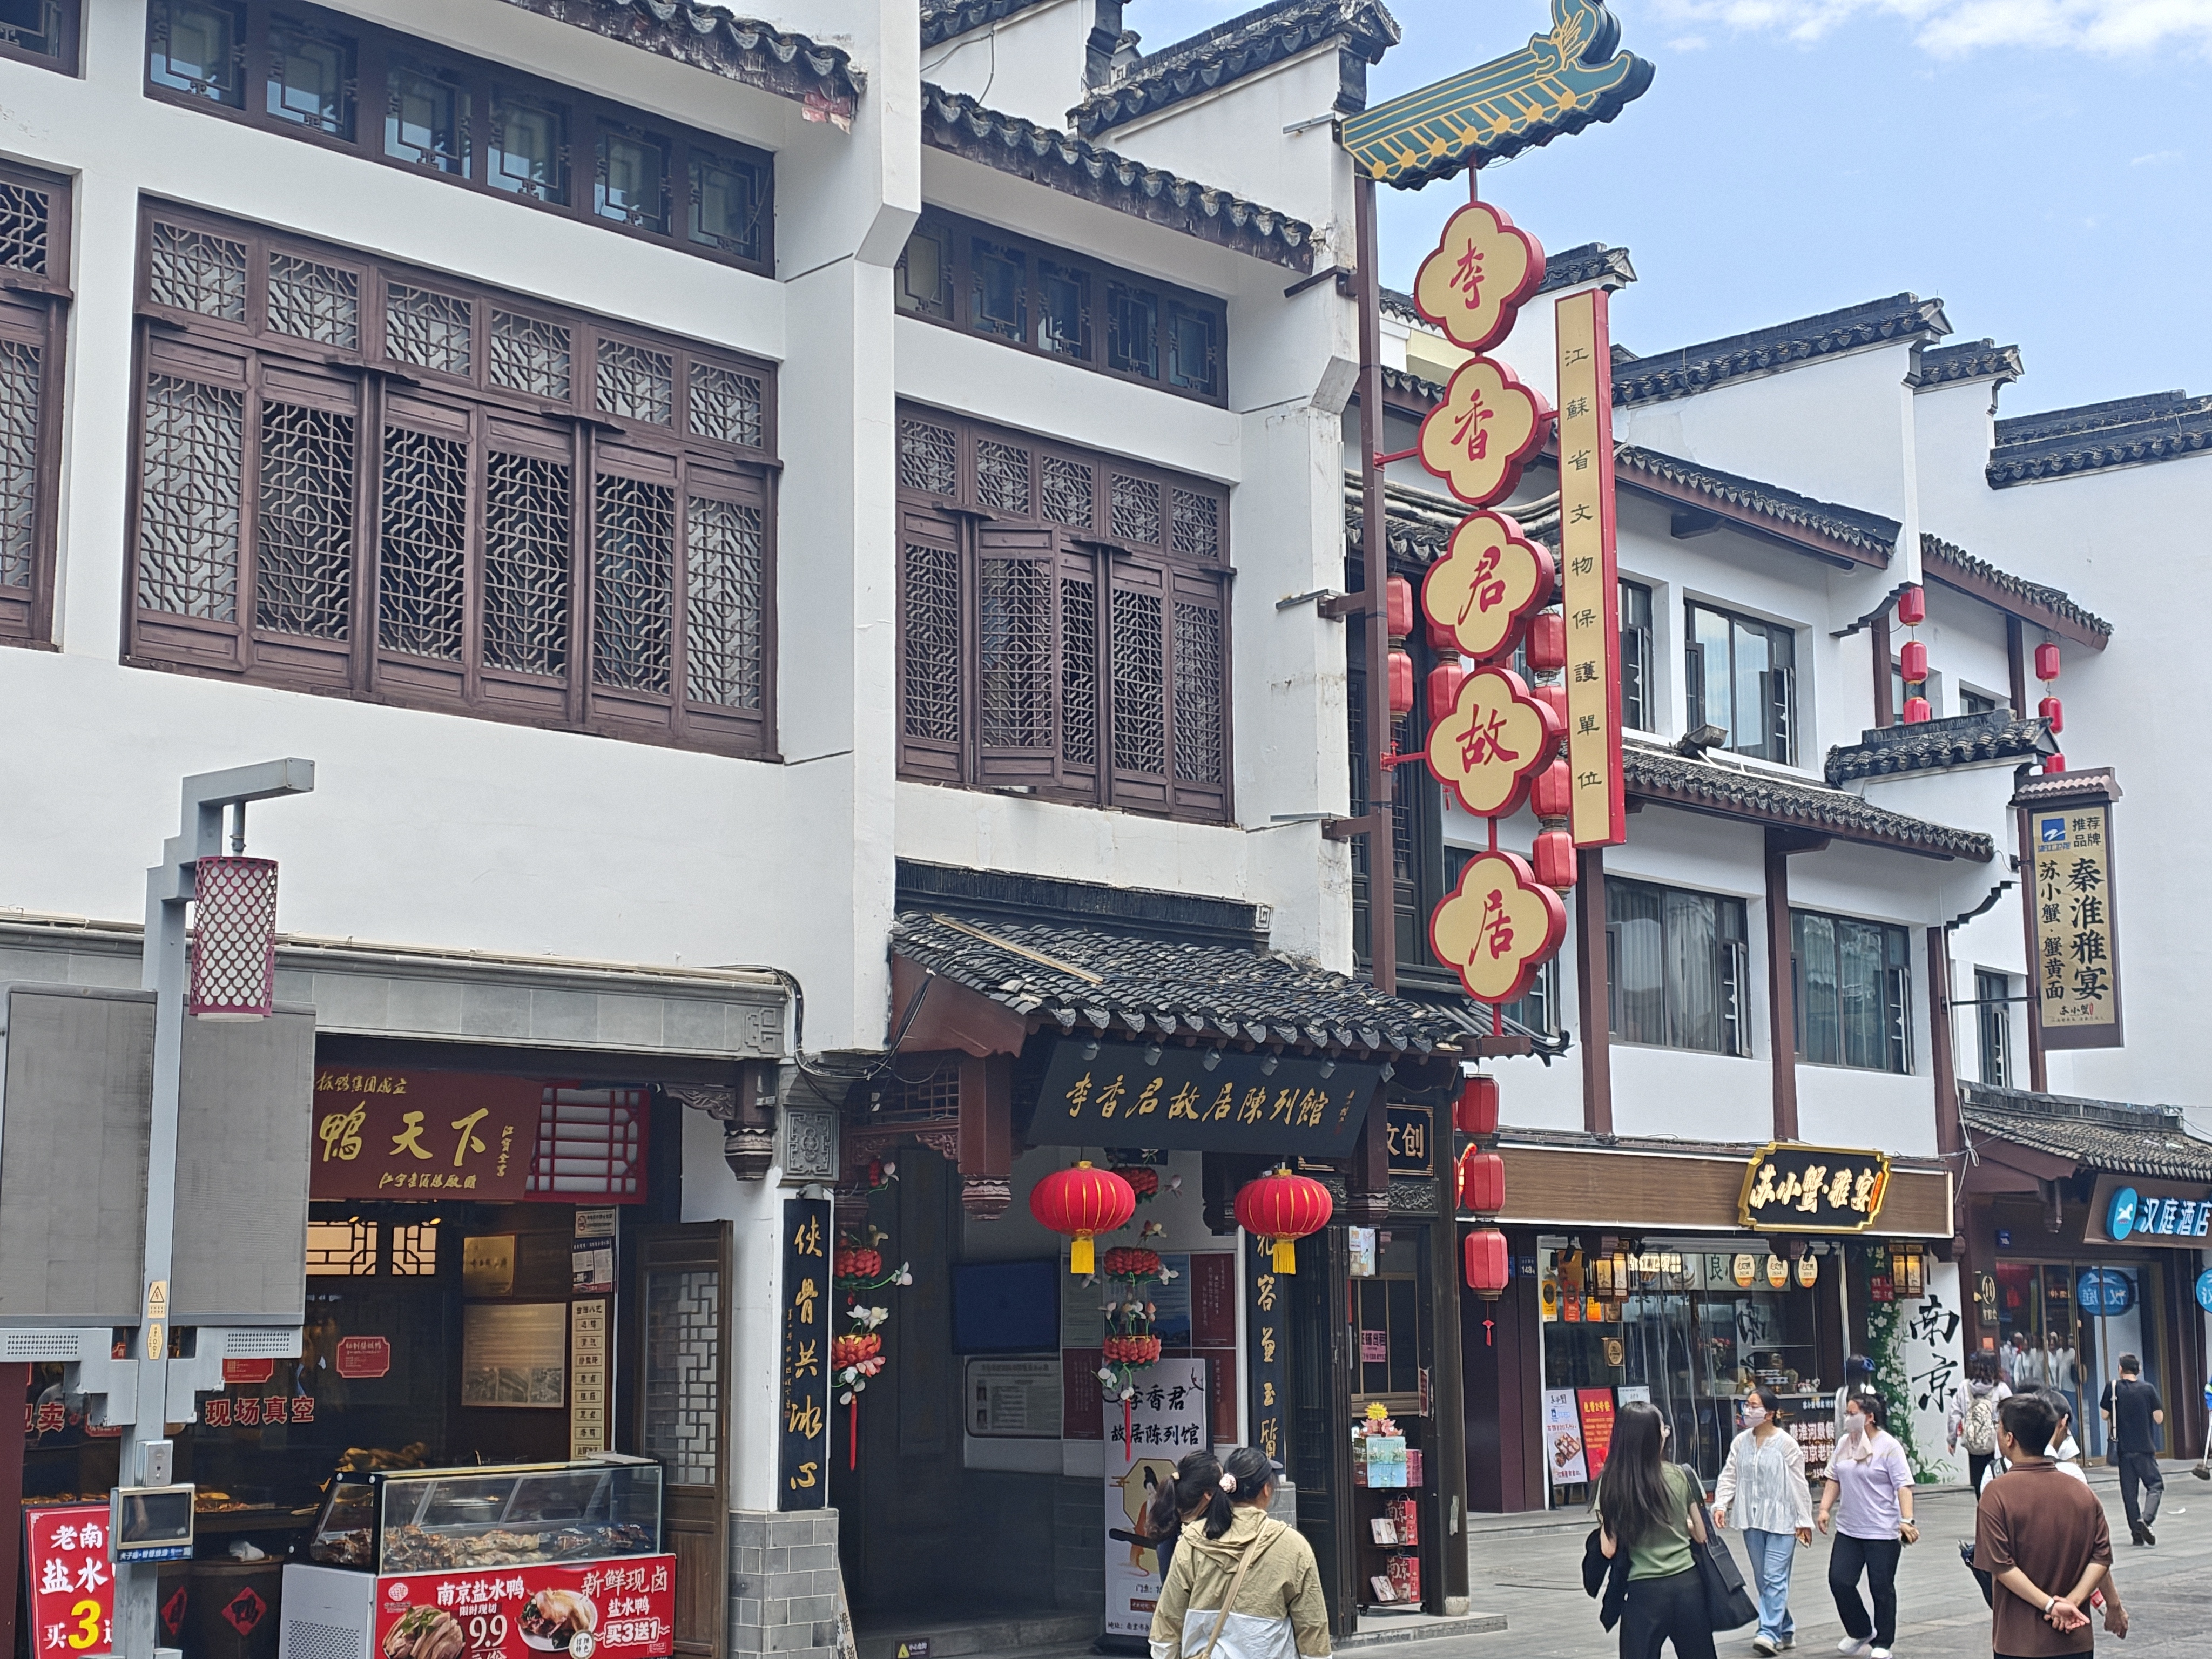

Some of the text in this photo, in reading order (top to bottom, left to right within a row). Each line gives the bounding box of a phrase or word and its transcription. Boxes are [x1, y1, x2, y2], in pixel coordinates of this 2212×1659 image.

[1564, 346, 1603, 790] 江蘇省文物保護單位
[1451, 238, 1519, 966] 李香君故居
[2072, 816, 2100, 832] 推荐
[2074, 833, 2101, 847] 品牌
[2066, 858, 2108, 1001] 秦淮雅宴
[1065, 1071, 1330, 1128] 李香君故居陳列館
[2139, 1197, 2212, 1237] 汉庭酒店
[1909, 1294, 1960, 1413] 南京
[205, 1395, 315, 1427] 现场真空
[1111, 1422, 1200, 1445] 故居陈列馆
[50, 1522, 110, 1551] 老南
[39, 1557, 116, 1595] 盐水
[436, 1575, 525, 1606] 南京盐水鸭
[580, 1565, 668, 1602] 新鲜现卤
[606, 1595, 650, 1618] 盐水鸭
[469, 1615, 508, 1649] 9.9
[606, 1620, 659, 1643] 买3送1
